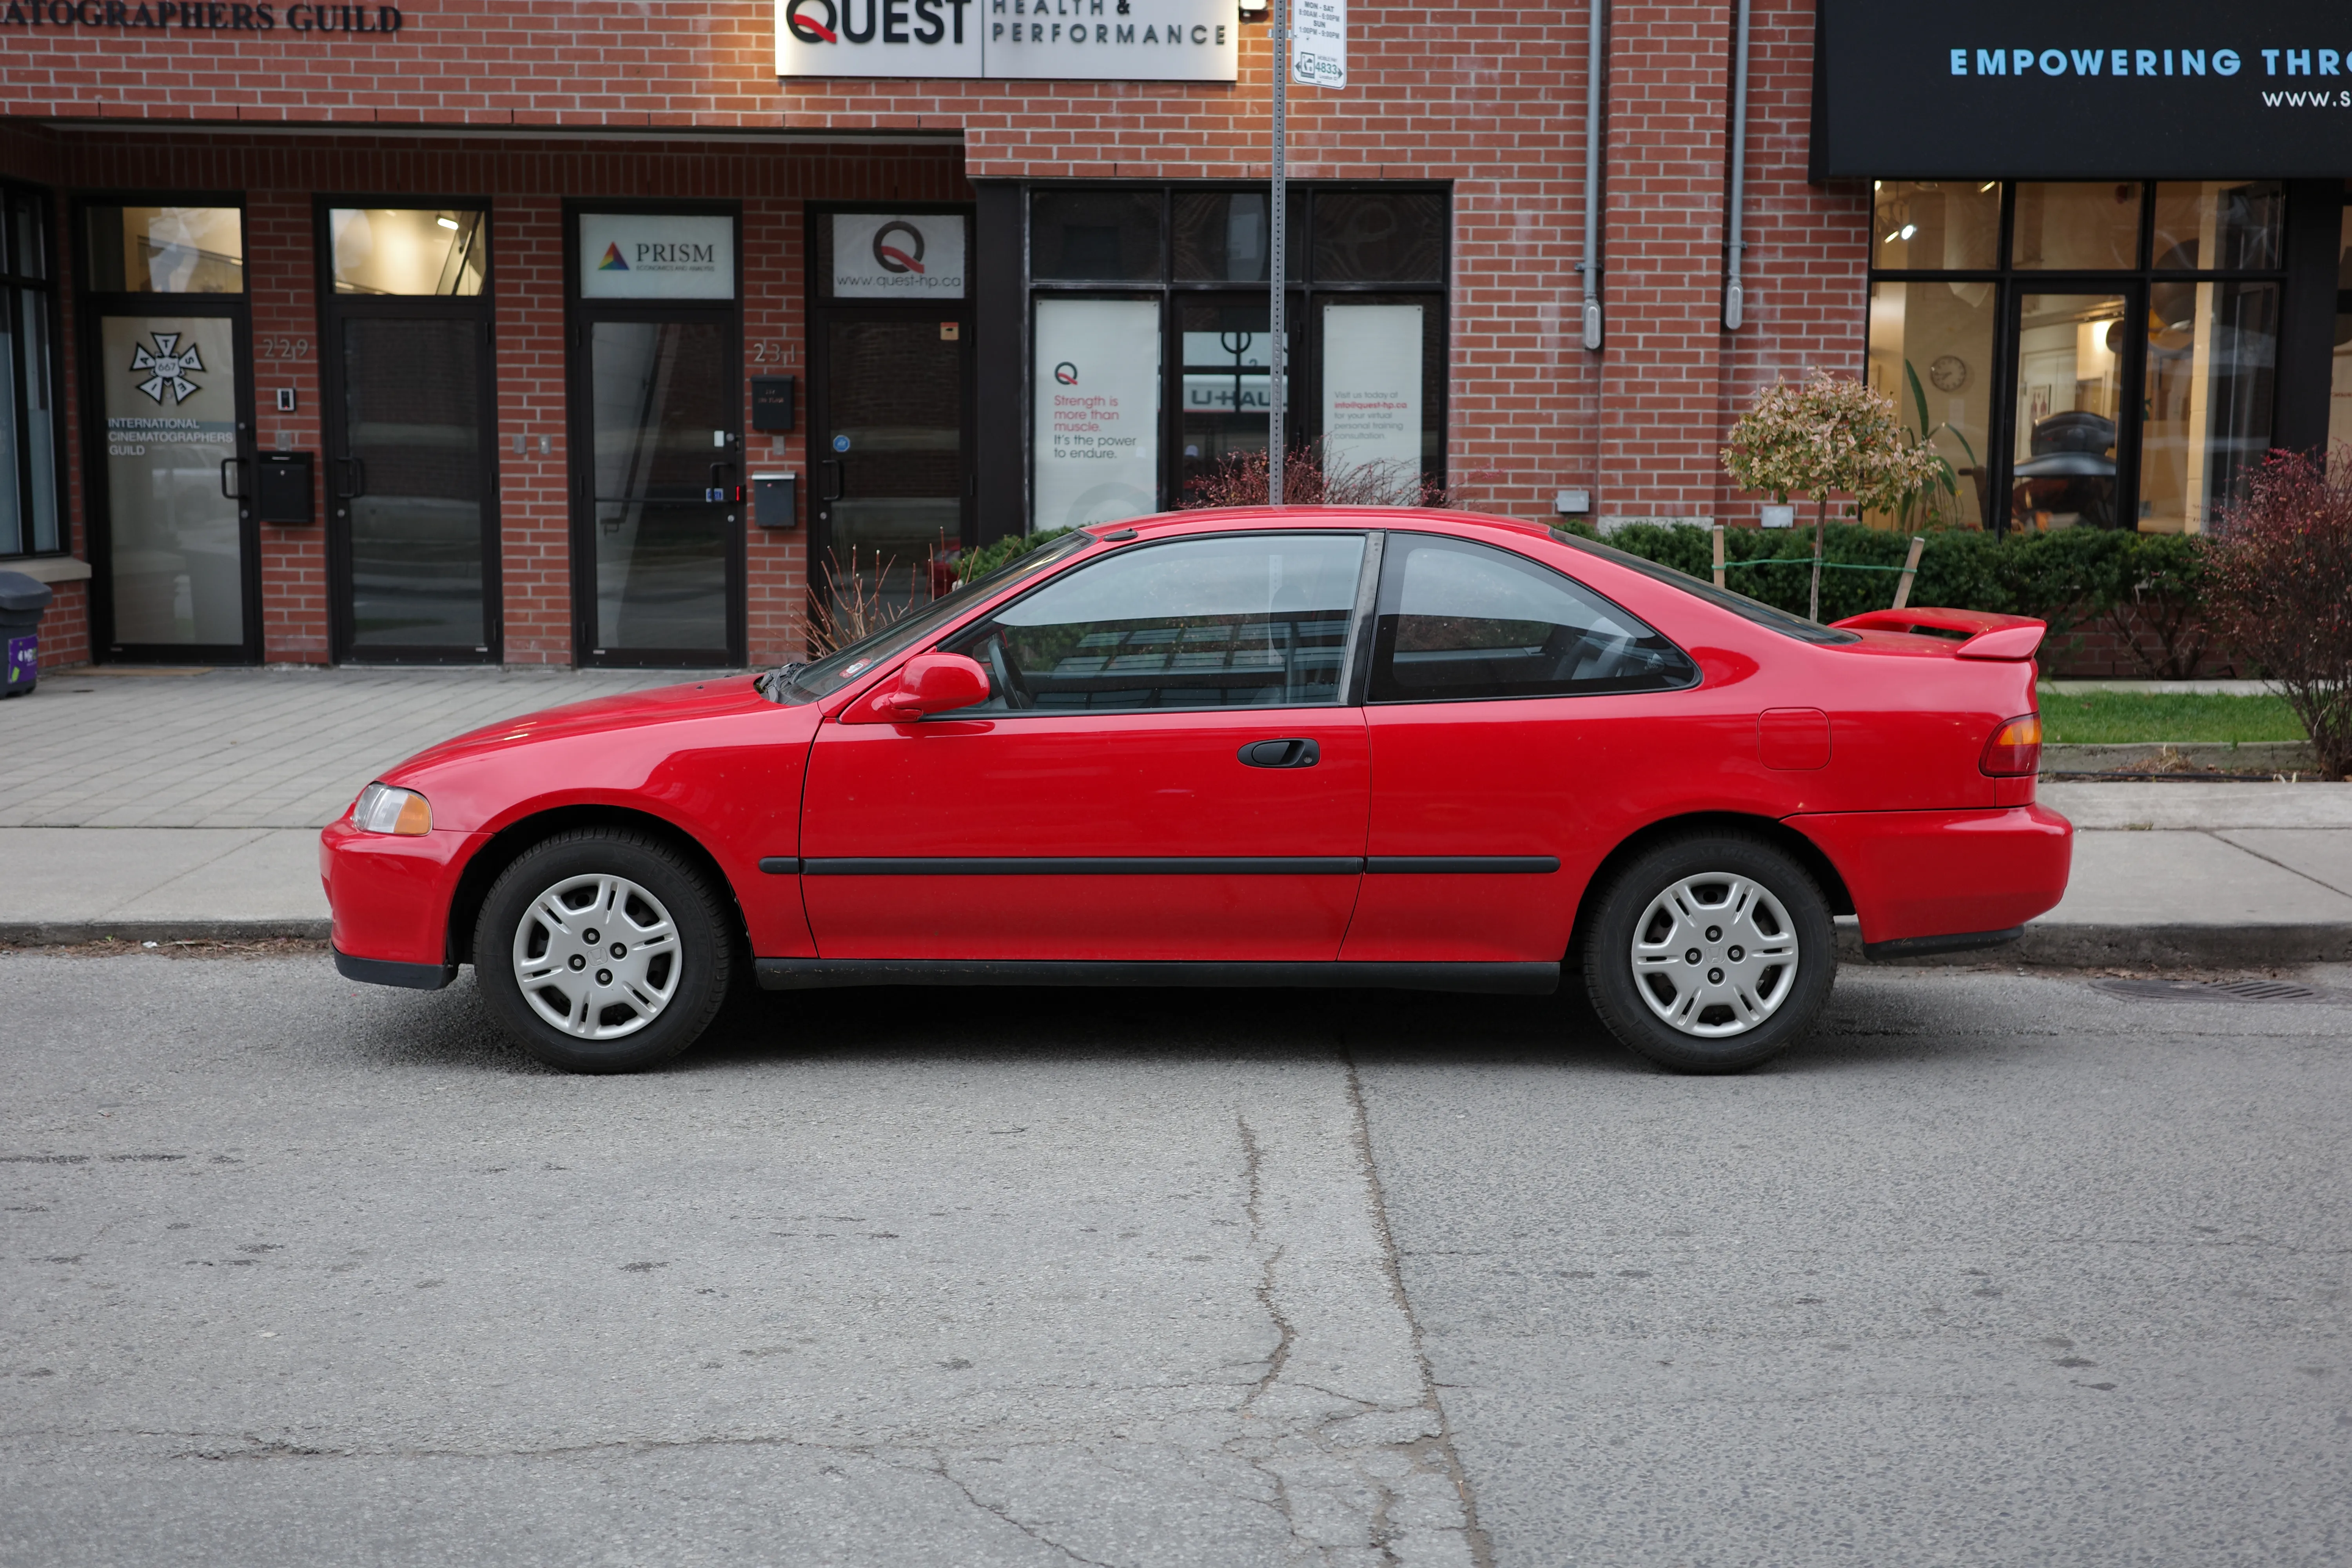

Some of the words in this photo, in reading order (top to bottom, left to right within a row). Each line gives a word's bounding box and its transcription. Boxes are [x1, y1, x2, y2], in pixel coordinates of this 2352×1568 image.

[993, 0, 1103, 15] HEALTH
[1117, 0, 1130, 15] &
[1305, 1, 1318, 9] MON
[287, 4, 401, 33] GUILD
[786, 0, 971, 44] QUEST
[993, 23, 1225, 44] PERFORMANCE
[1315, 62, 1337, 74] 4833
[1950, 48, 2241, 76] EMPOWERING
[2261, 49, 2352, 76] THR
[2261, 91, 2352, 107] www.s
[636, 243, 715, 263] PRISM
[837, 274, 962, 289] www.quest-hp.ca
[263, 338, 309, 358] 229
[753, 343, 796, 363] 231
[158, 363, 176, 372] 667
[1054, 395, 1105, 409] Strength
[1109, 395, 1118, 406] is
[1192, 390, 1288, 407] U-HAU
[1365, 391, 1388, 399] today
[1054, 411, 1087, 419] more
[1091, 409, 1119, 419] than
[108, 417, 200, 429] INTERNATIONAL
[1054, 421, 1102, 431] muscle.
[1373, 422, 1404, 431] training
[108, 431, 234, 443] CINEMATOGRAPHERS
[1054, 434, 1070, 445] It's
[1074, 434, 1093, 445] the
[1098, 437, 1136, 448] power
[109, 445, 145, 456] GUILD
[1054, 448, 1066, 458] to
[1070, 448, 1117, 458] endure.
